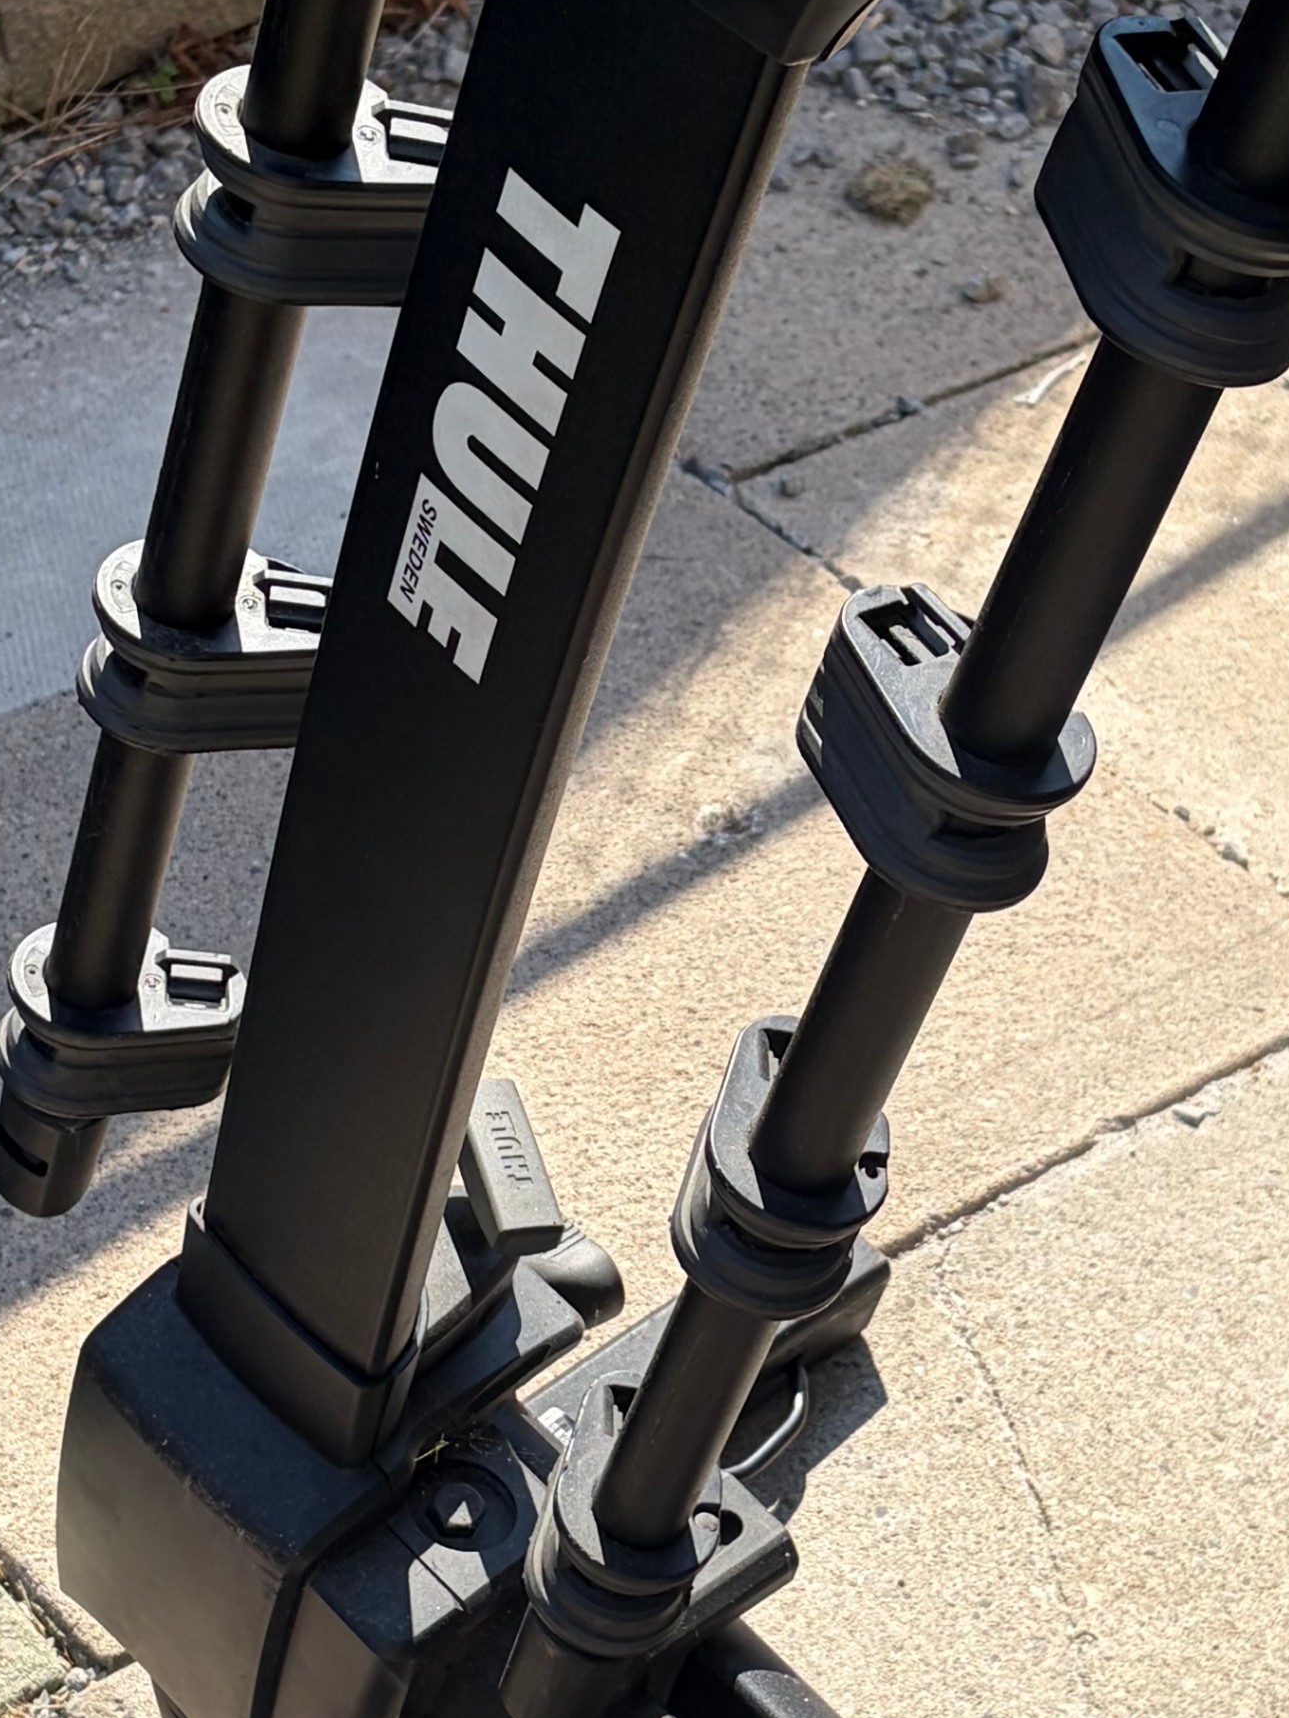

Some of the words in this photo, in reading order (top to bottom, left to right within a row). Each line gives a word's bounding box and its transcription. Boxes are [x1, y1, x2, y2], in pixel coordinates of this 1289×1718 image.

[387, 167, 621, 683] THULE
[400, 499, 437, 603] SWEDEN
[485, 1111, 534, 1189] THULE
